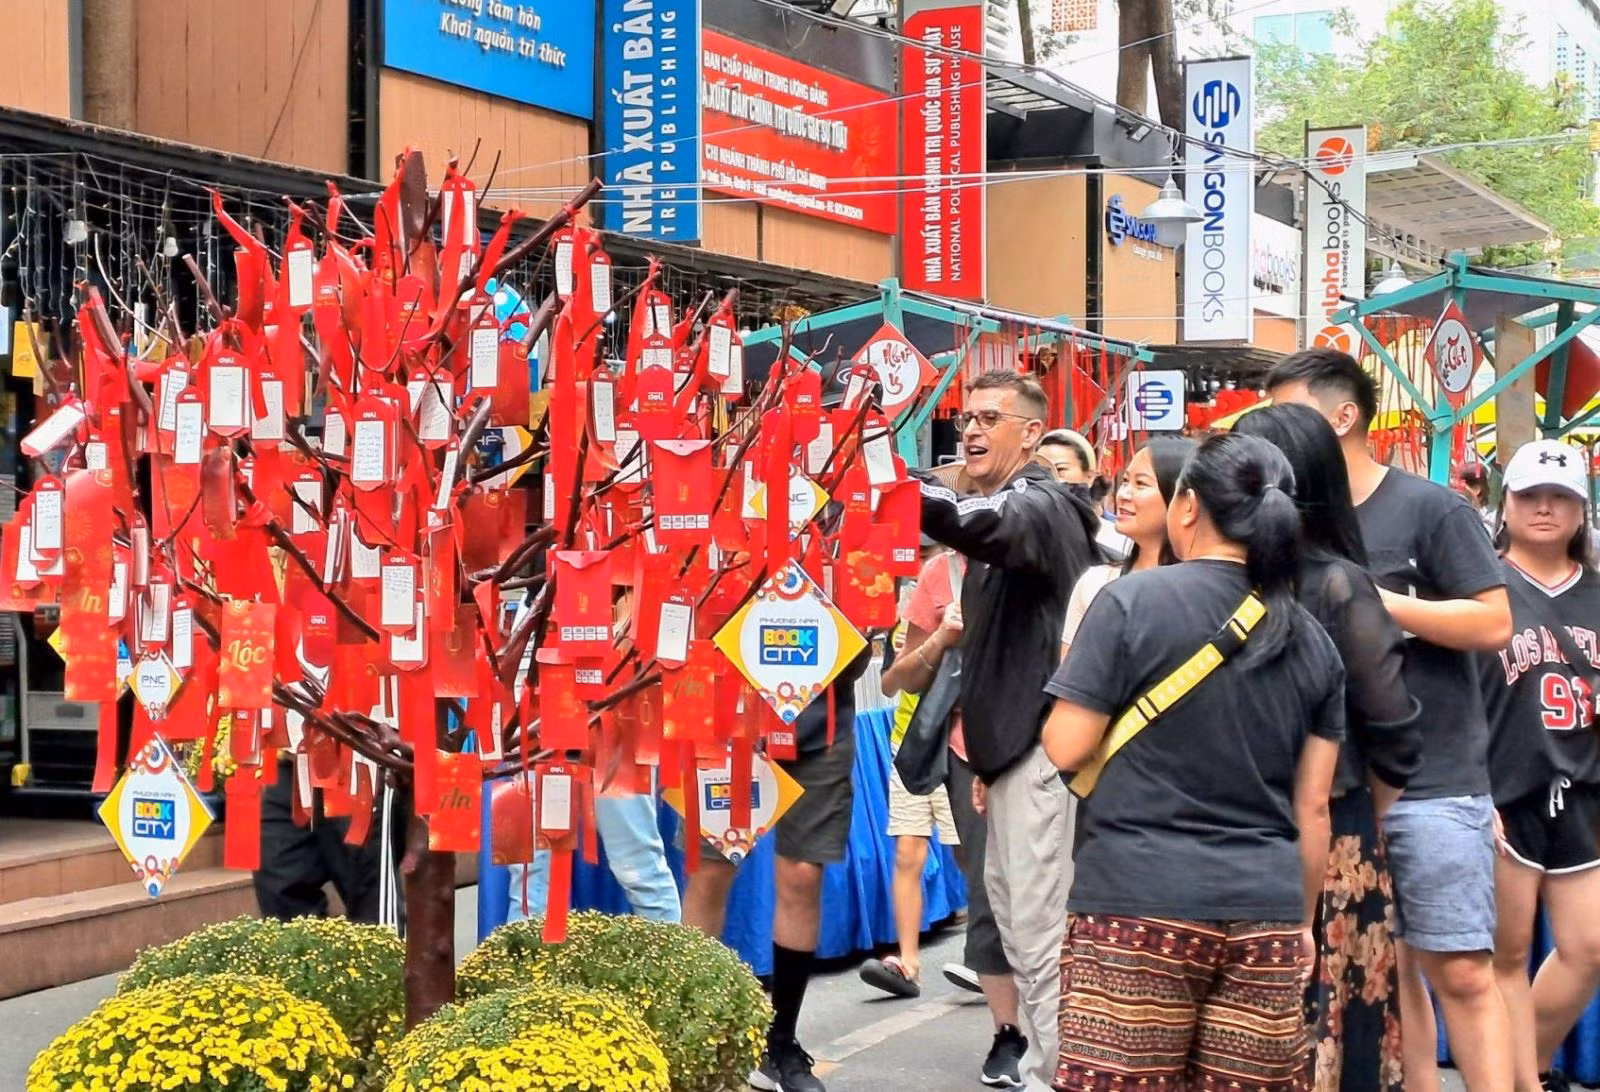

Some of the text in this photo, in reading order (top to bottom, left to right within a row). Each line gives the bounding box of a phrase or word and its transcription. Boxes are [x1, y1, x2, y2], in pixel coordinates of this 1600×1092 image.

[703, 50, 720, 71] BAN
[721, 53, 742, 77] CHẤP
[743, 61, 764, 86] HÀNH
[764, 70, 789, 94] TRUNG
[660, 10, 677, 171] PUBLISHING
[709, 79, 731, 113] XUẤT
[925, 77, 942, 98] GIA
[611, 70, 653, 153] XUẤT
[920, 100, 943, 132] QUỐC
[950, 72, 961, 147] PUBLISHING
[950, 151, 961, 214] POLITICAL
[615, 161, 653, 233] NHÀ
[920, 196, 942, 222] BẢN
[920, 224, 942, 254] XUẤT
[1342, 227, 1349, 239] is
[950, 217, 961, 281] NATIONAL
[922, 256, 942, 282] NHÀ
[1341, 240, 1350, 288] knowledge
[479, 319, 492, 327] deli
[650, 339, 664, 347] deli
[647, 391, 664, 401] deli
[788, 492, 808, 503] NC
[310, 615, 326, 625] deli
[763, 629, 815, 646] BOOK
[763, 647, 815, 663] CITY
[1498, 627, 1542, 686] LOS
[141, 675, 166, 686] PNC
[135, 801, 172, 819] BOOK
[134, 820, 173, 837] CITY
